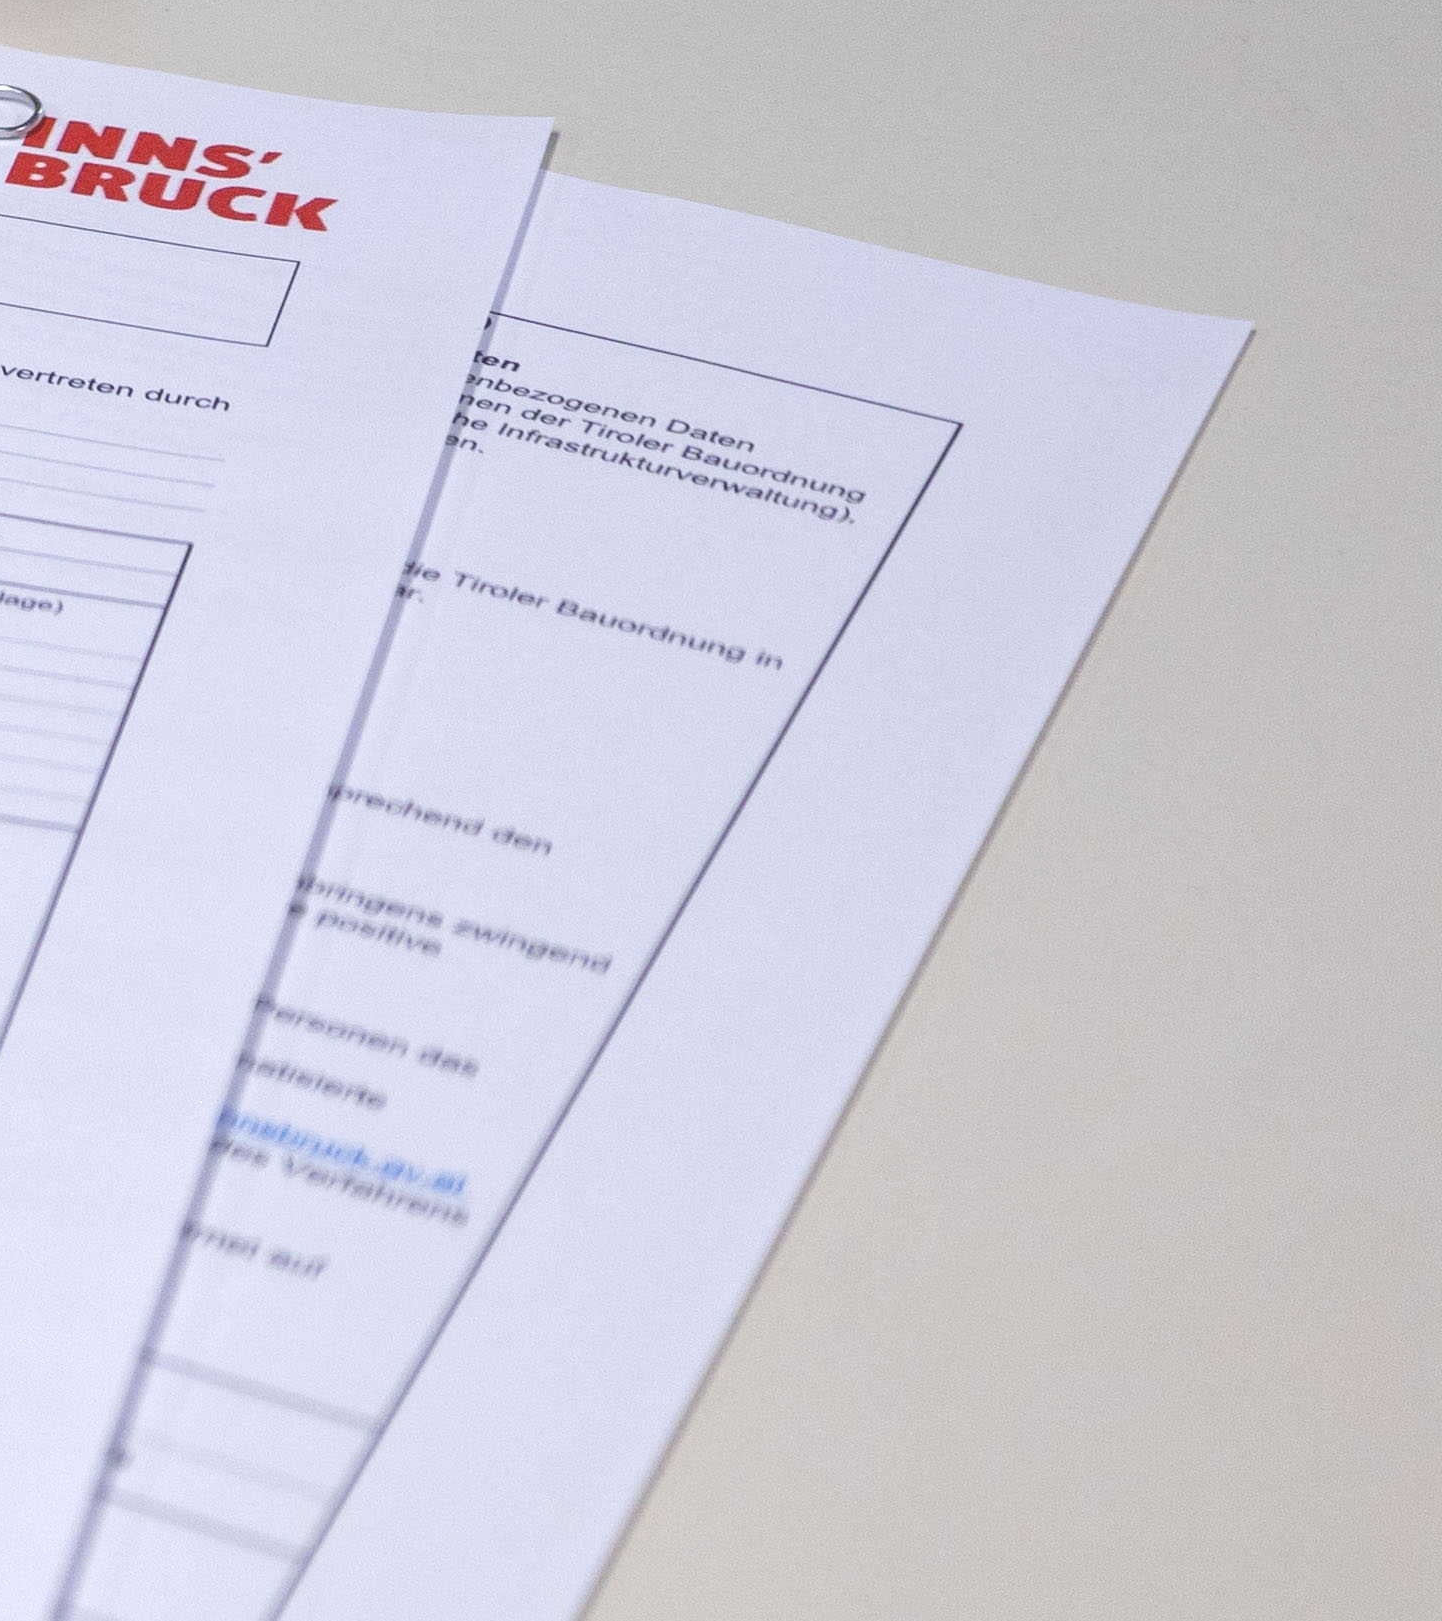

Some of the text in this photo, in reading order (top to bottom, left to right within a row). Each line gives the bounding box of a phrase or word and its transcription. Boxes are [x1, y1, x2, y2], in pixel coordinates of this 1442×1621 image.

[20, 117, 284, 178] INNS'
[5, 152, 339, 232] BRUCK
[0, 365, 229, 411] vertreten durch
[523, 402, 573, 431] der
[582, 417, 674, 459] Tiroler
[679, 441, 867, 505] Bauordnung
[669, 417, 755, 454] Daten
[498, 421, 857, 525] Infrastrukturverwaltung).
[454, 572, 550, 611] Tiroler
[556, 599, 747, 663] Bauordnung
[755, 649, 784, 671] in
[492, 826, 553, 856] den
